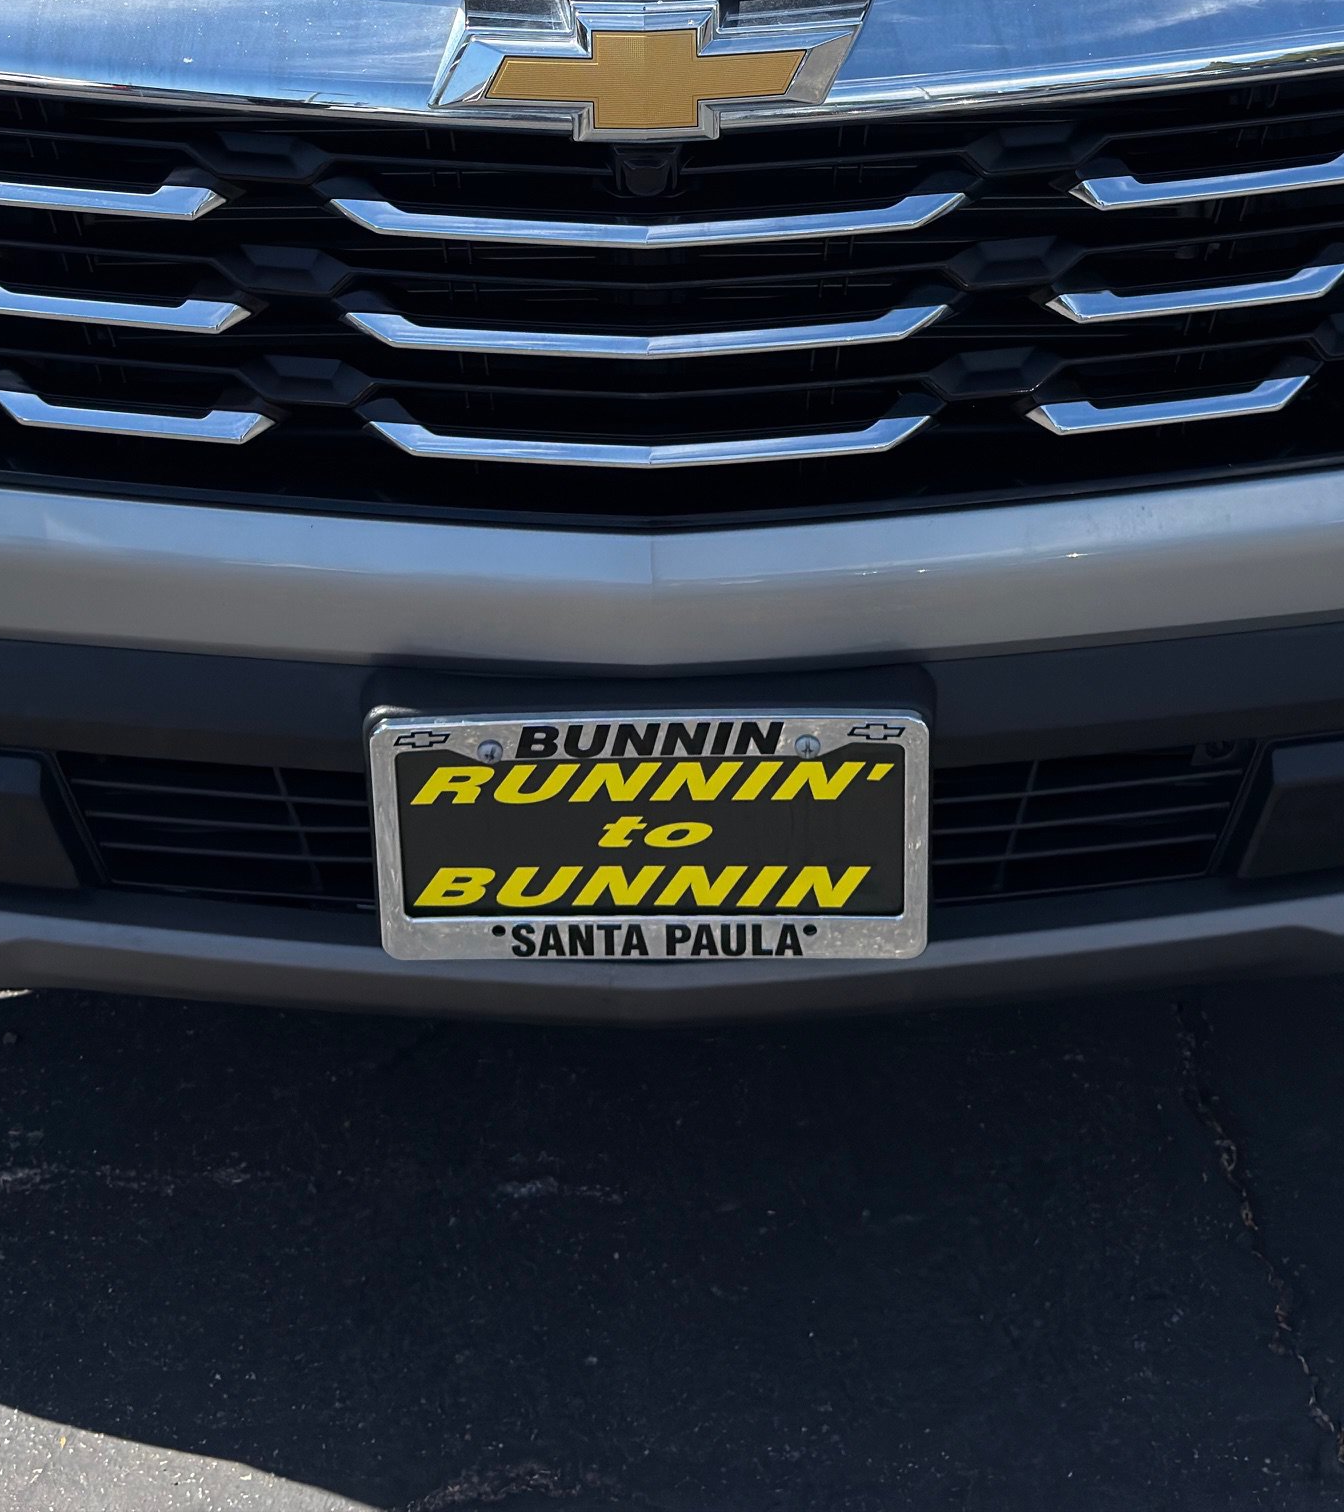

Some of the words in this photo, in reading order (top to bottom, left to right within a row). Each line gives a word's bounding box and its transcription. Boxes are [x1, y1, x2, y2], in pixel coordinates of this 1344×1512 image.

[515, 721, 785, 760] BUNNIN
[409, 760, 895, 806] RUNNIN'
[597, 815, 714, 848] to
[413, 865, 872, 909] BUNNIN
[511, 924, 648, 957] SANTA
[665, 923, 804, 956] PAULA
